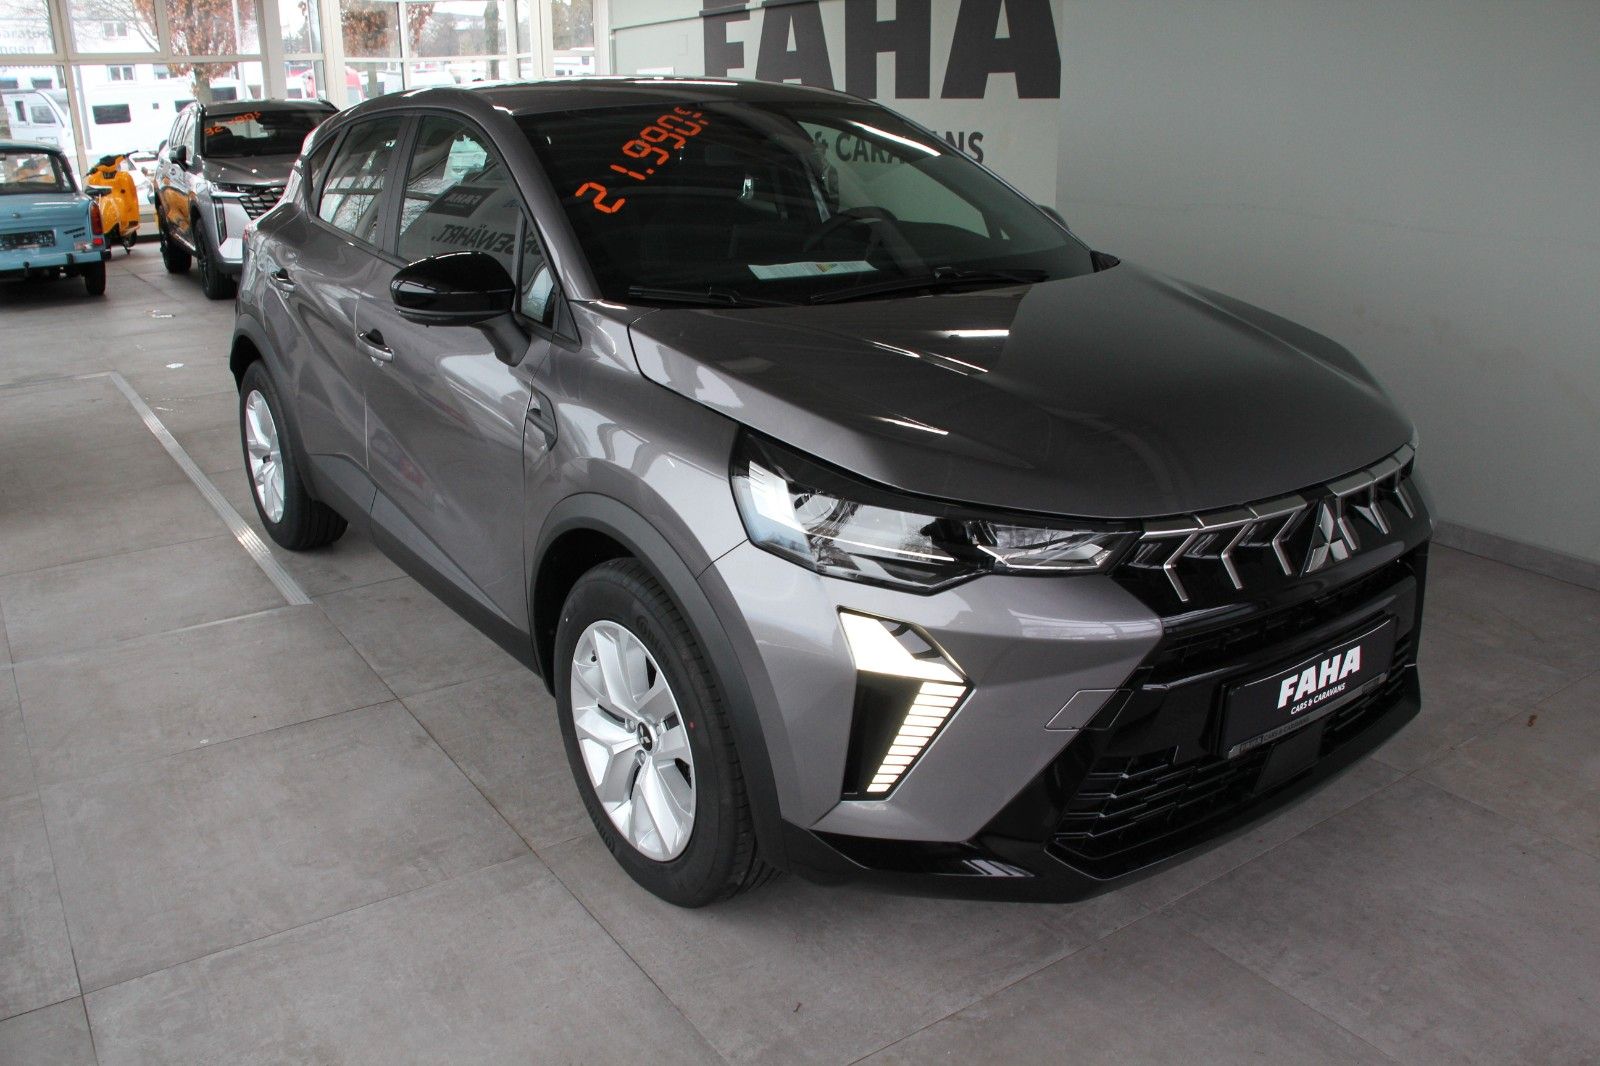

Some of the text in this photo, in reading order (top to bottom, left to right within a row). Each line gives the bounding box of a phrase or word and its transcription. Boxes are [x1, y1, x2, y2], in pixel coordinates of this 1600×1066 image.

[703, 0, 1061, 99] FAHA
[836, 131, 984, 165] CARNS
[1277, 645, 1361, 709] FAHA
[1291, 701, 1307, 715] CARS
[1314, 682, 1346, 704] CARAVANS
